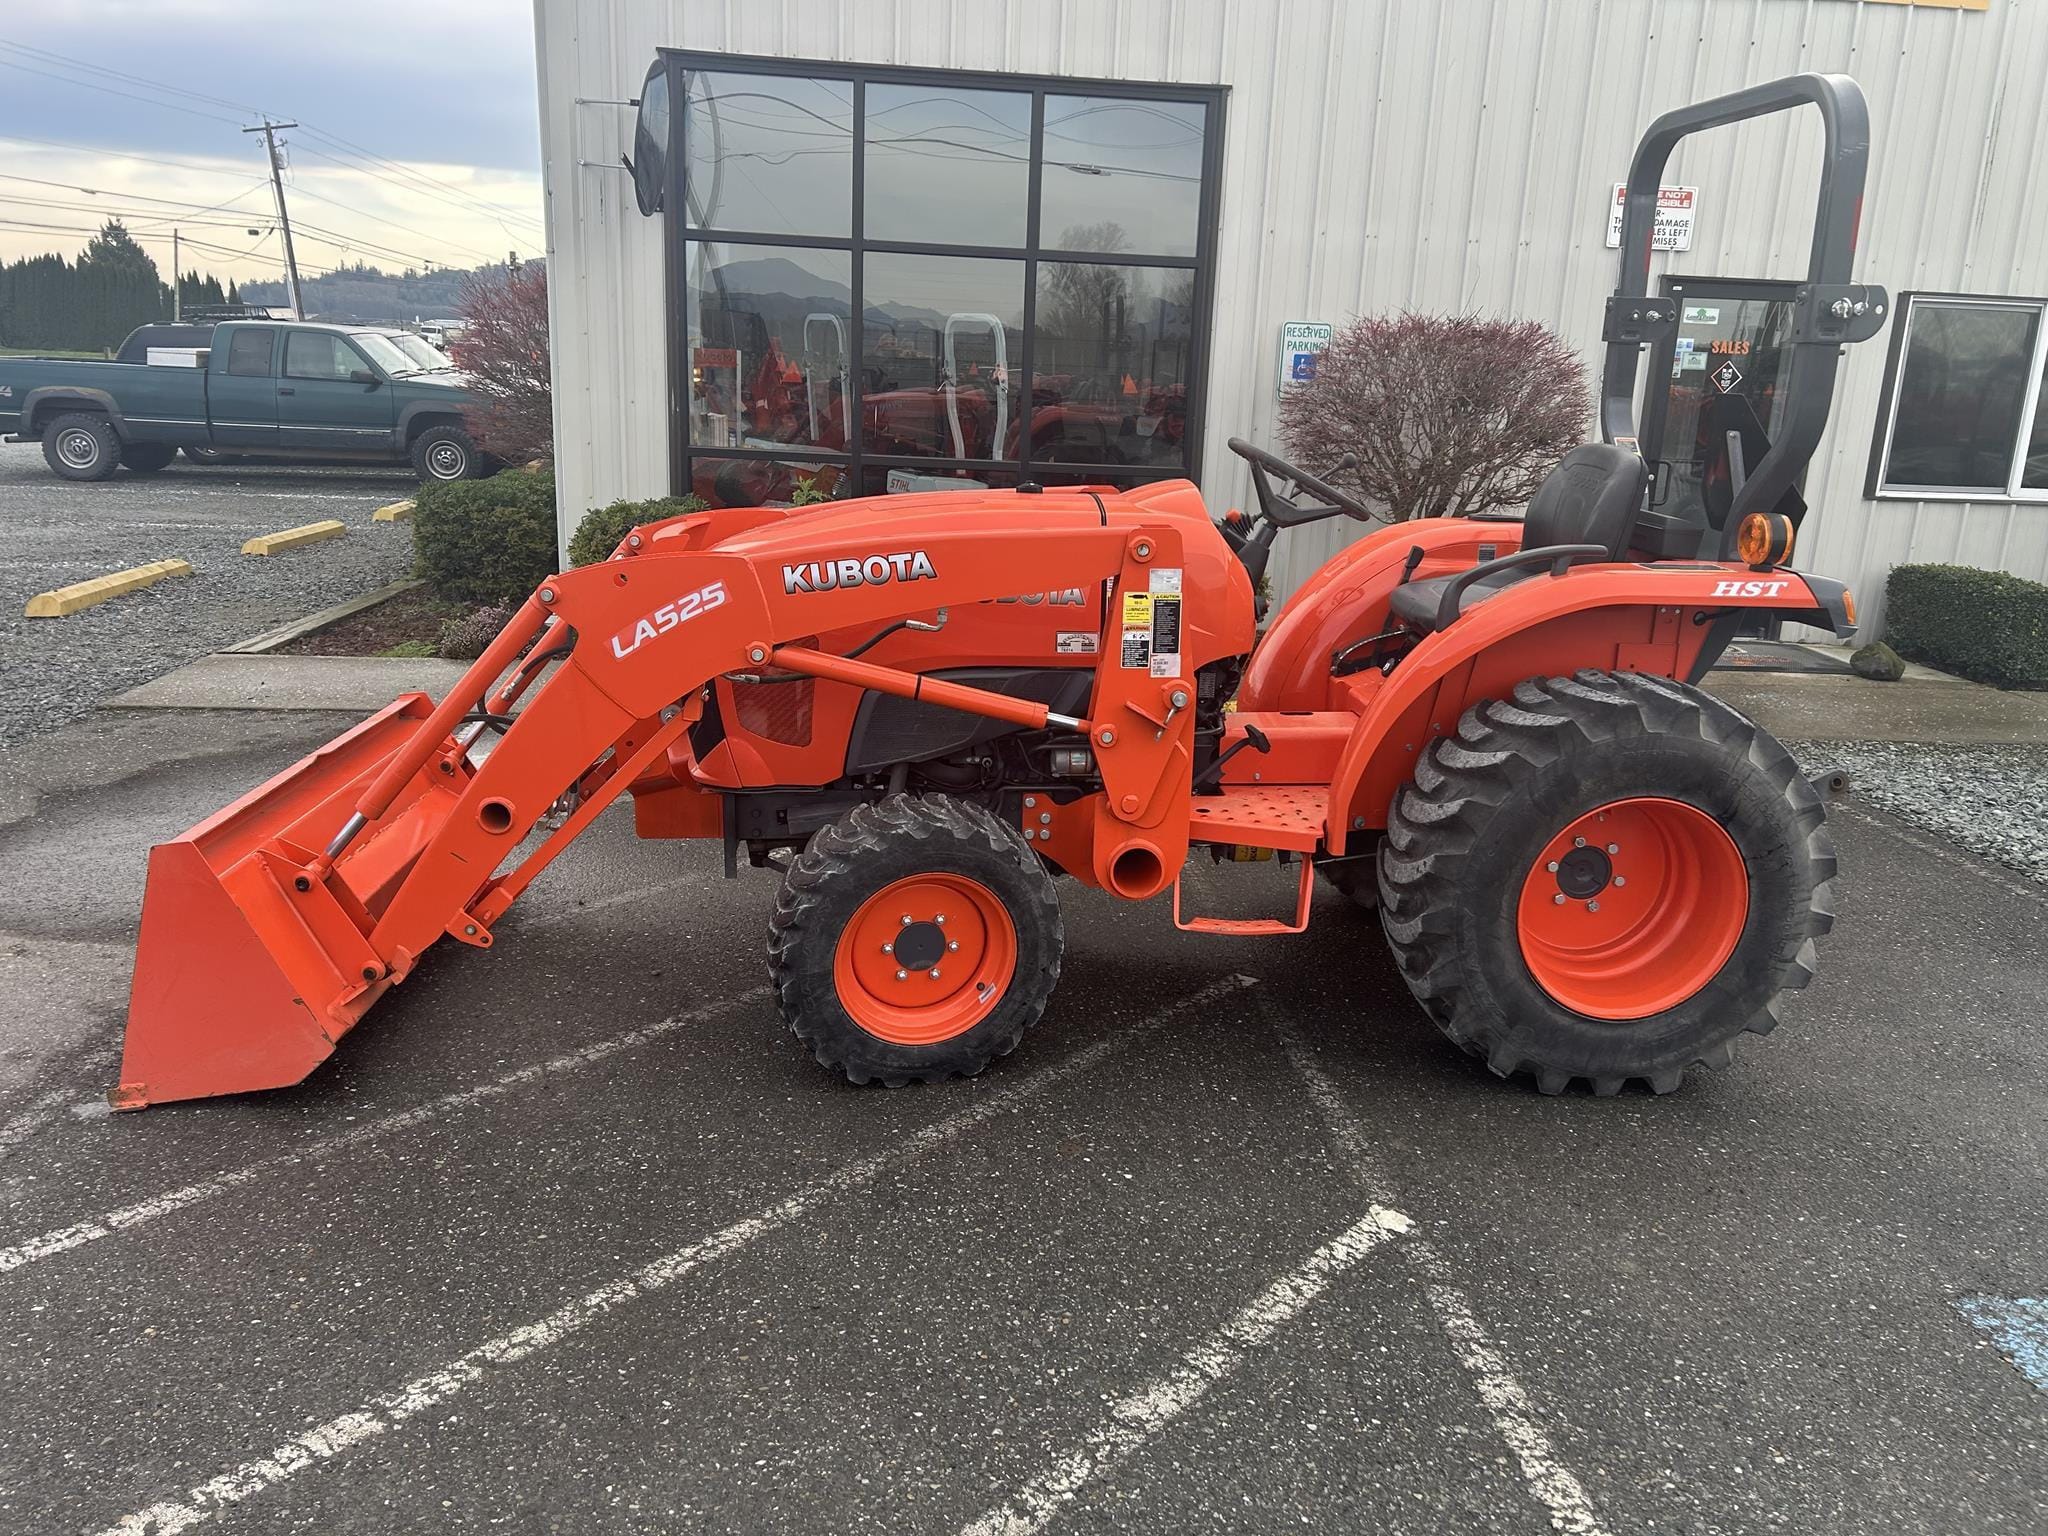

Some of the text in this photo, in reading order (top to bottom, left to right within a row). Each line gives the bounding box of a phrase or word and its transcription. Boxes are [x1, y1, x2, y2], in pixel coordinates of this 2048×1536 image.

[1668, 229, 1688, 237] LEFT
[1286, 327, 1329, 339] RESERVED
[1711, 340, 1750, 355] SALES
[890, 478, 911, 492] STIHL
[782, 551, 937, 595] KUBOTA
[1709, 581, 1789, 597] HST
[611, 582, 727, 659] LA525
